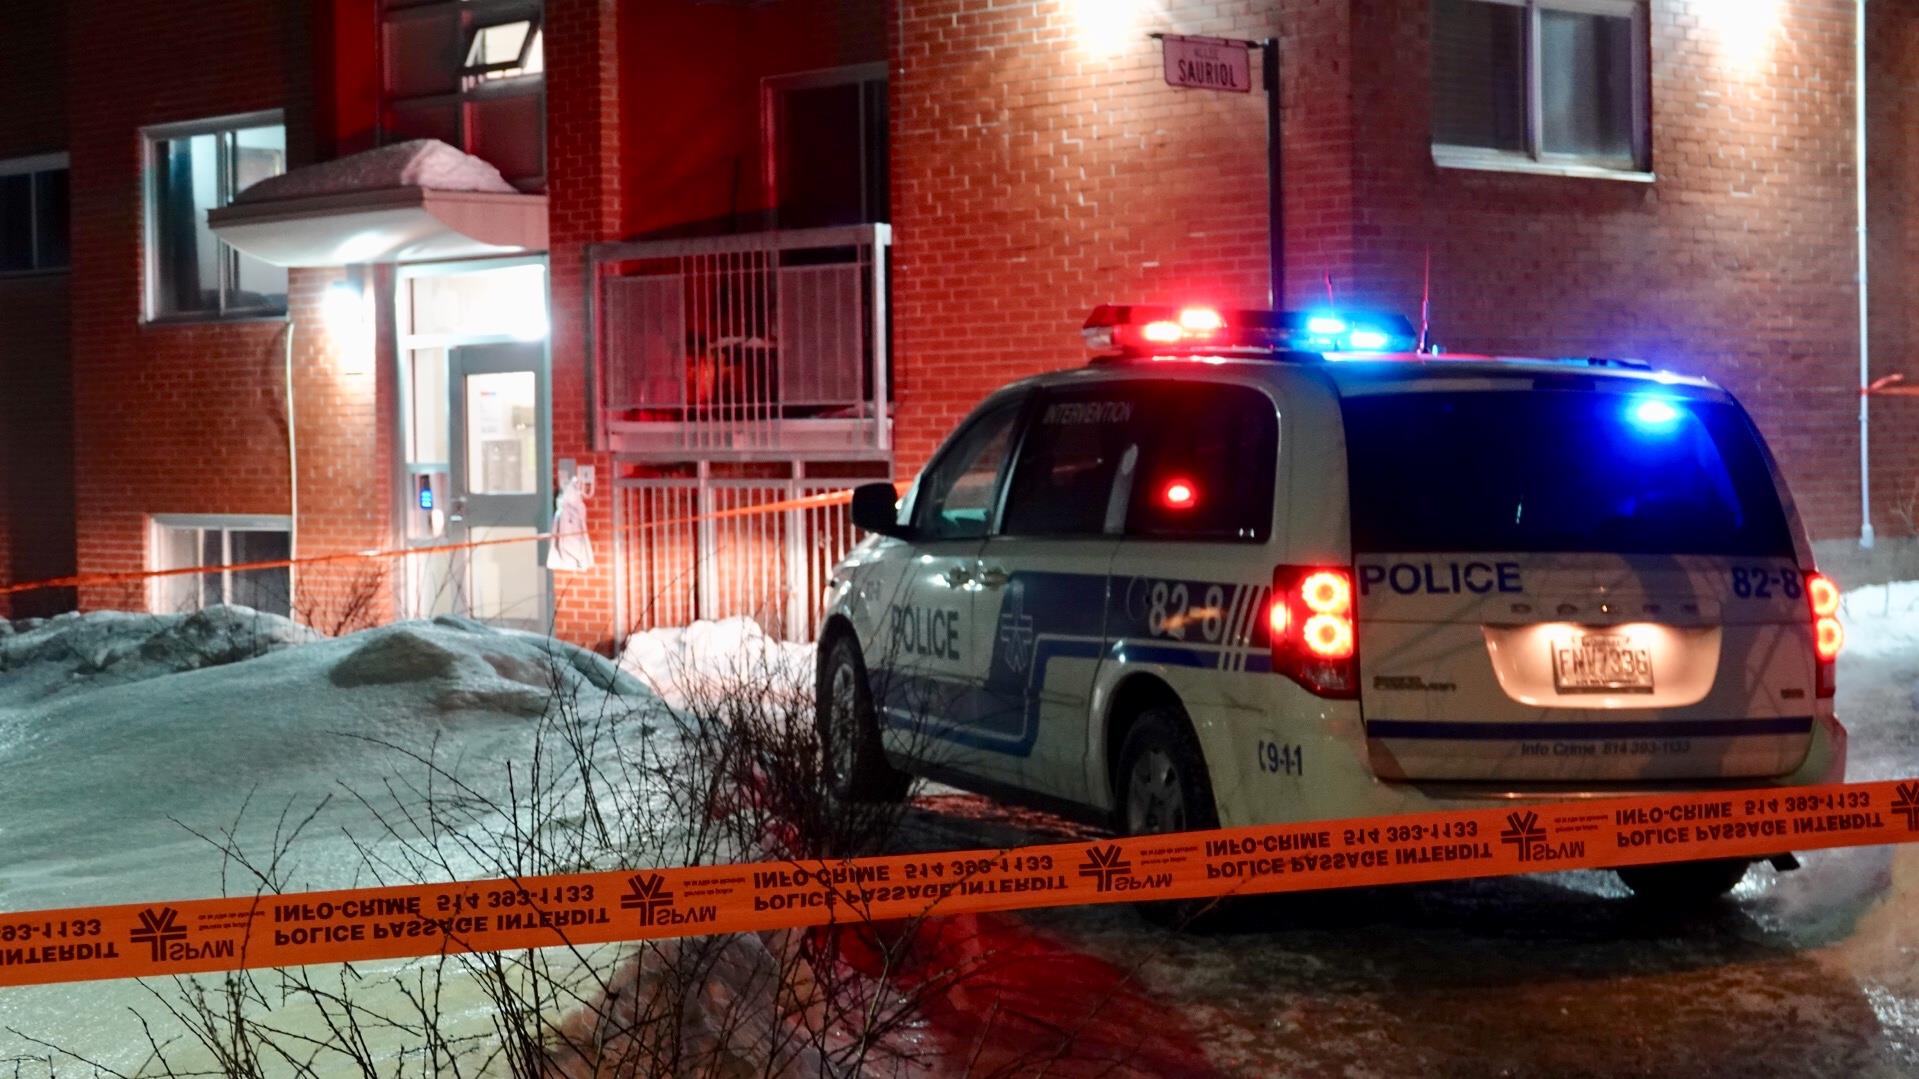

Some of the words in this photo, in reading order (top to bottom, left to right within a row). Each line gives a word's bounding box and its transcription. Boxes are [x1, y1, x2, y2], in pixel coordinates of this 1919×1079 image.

[1178, 59, 1237, 87] SAURIOL
[1359, 562, 1523, 595] POLICE
[1732, 566, 1801, 599] 82-8
[891, 604, 960, 660] POLICE
[1521, 742, 1549, 756] Info
